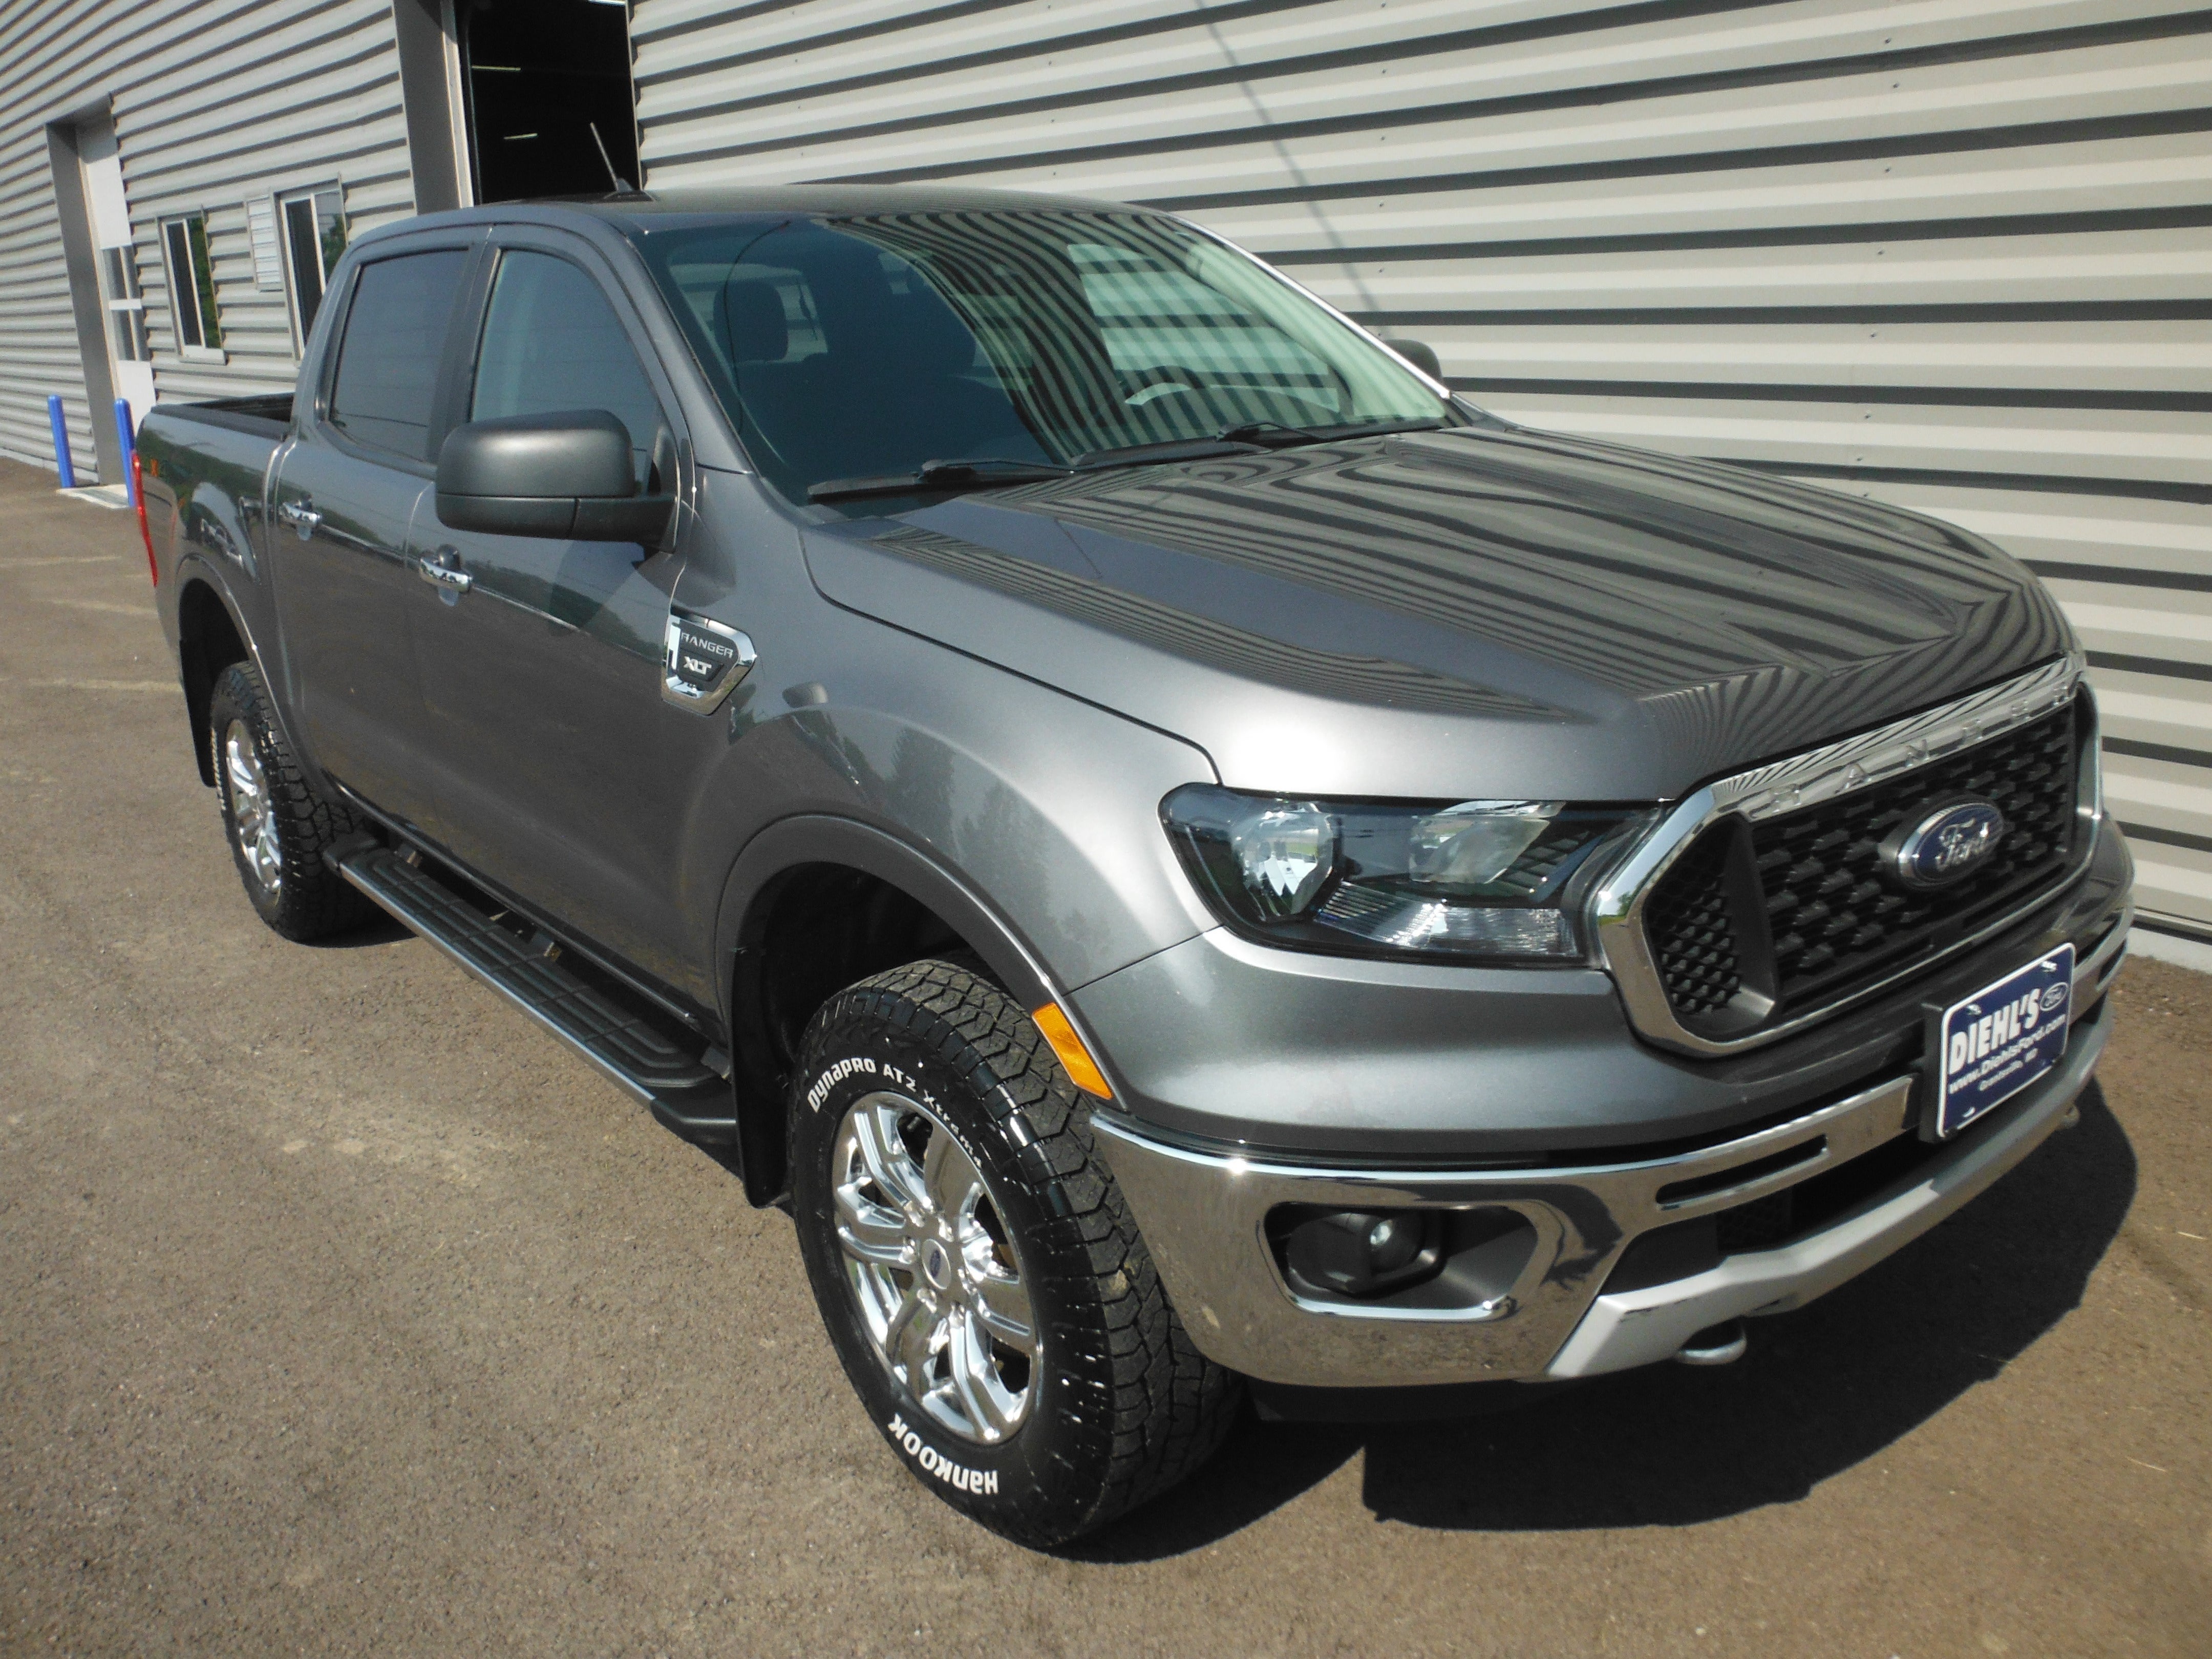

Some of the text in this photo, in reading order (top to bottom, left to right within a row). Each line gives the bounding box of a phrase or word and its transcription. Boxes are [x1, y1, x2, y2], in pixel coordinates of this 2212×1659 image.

[681, 632, 733, 658] RANGER
[683, 656, 712, 675] XLT
[1935, 818, 1990, 871] Ford
[1949, 988, 2040, 1075] DIEHL'S
